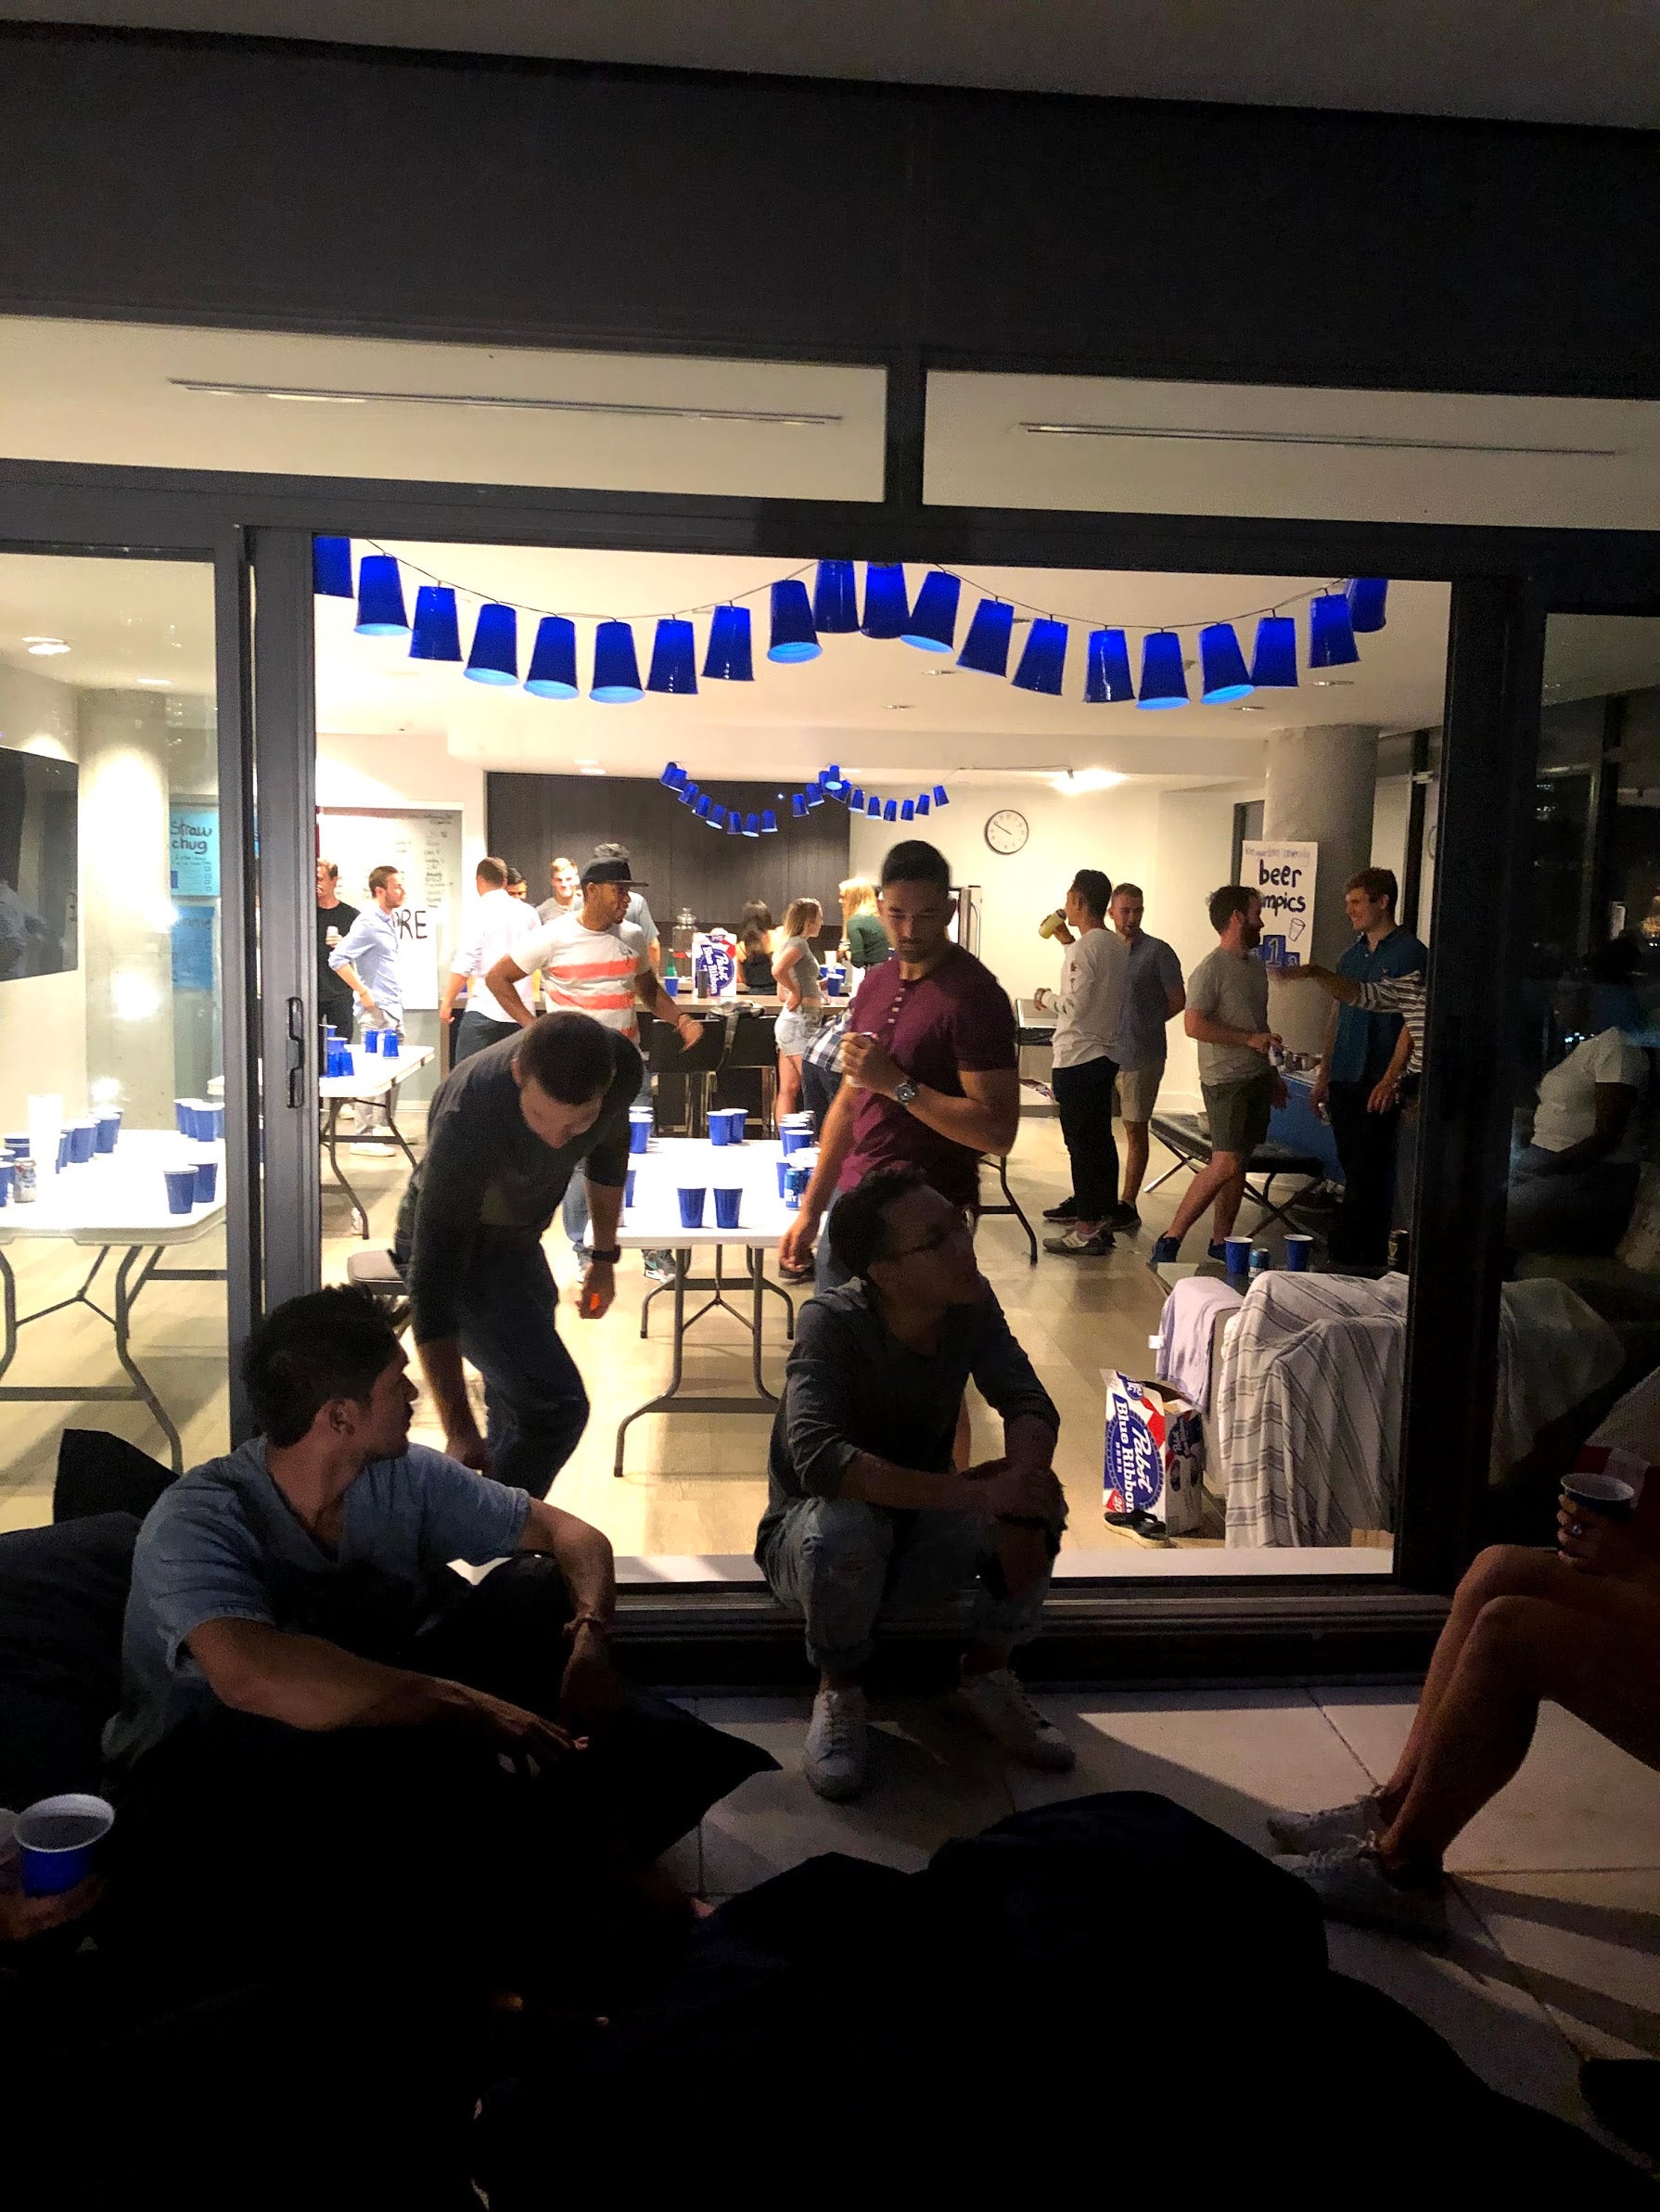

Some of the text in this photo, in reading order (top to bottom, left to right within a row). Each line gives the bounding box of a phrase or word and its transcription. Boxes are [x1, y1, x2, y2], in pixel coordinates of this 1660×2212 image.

[172, 838, 208, 854] chug
[1258, 859, 1302, 888] beer
[1266, 937, 1283, 966] 1
[1117, 1401, 1130, 1444] Blue
[1131, 1427, 1154, 1494] Pabst
